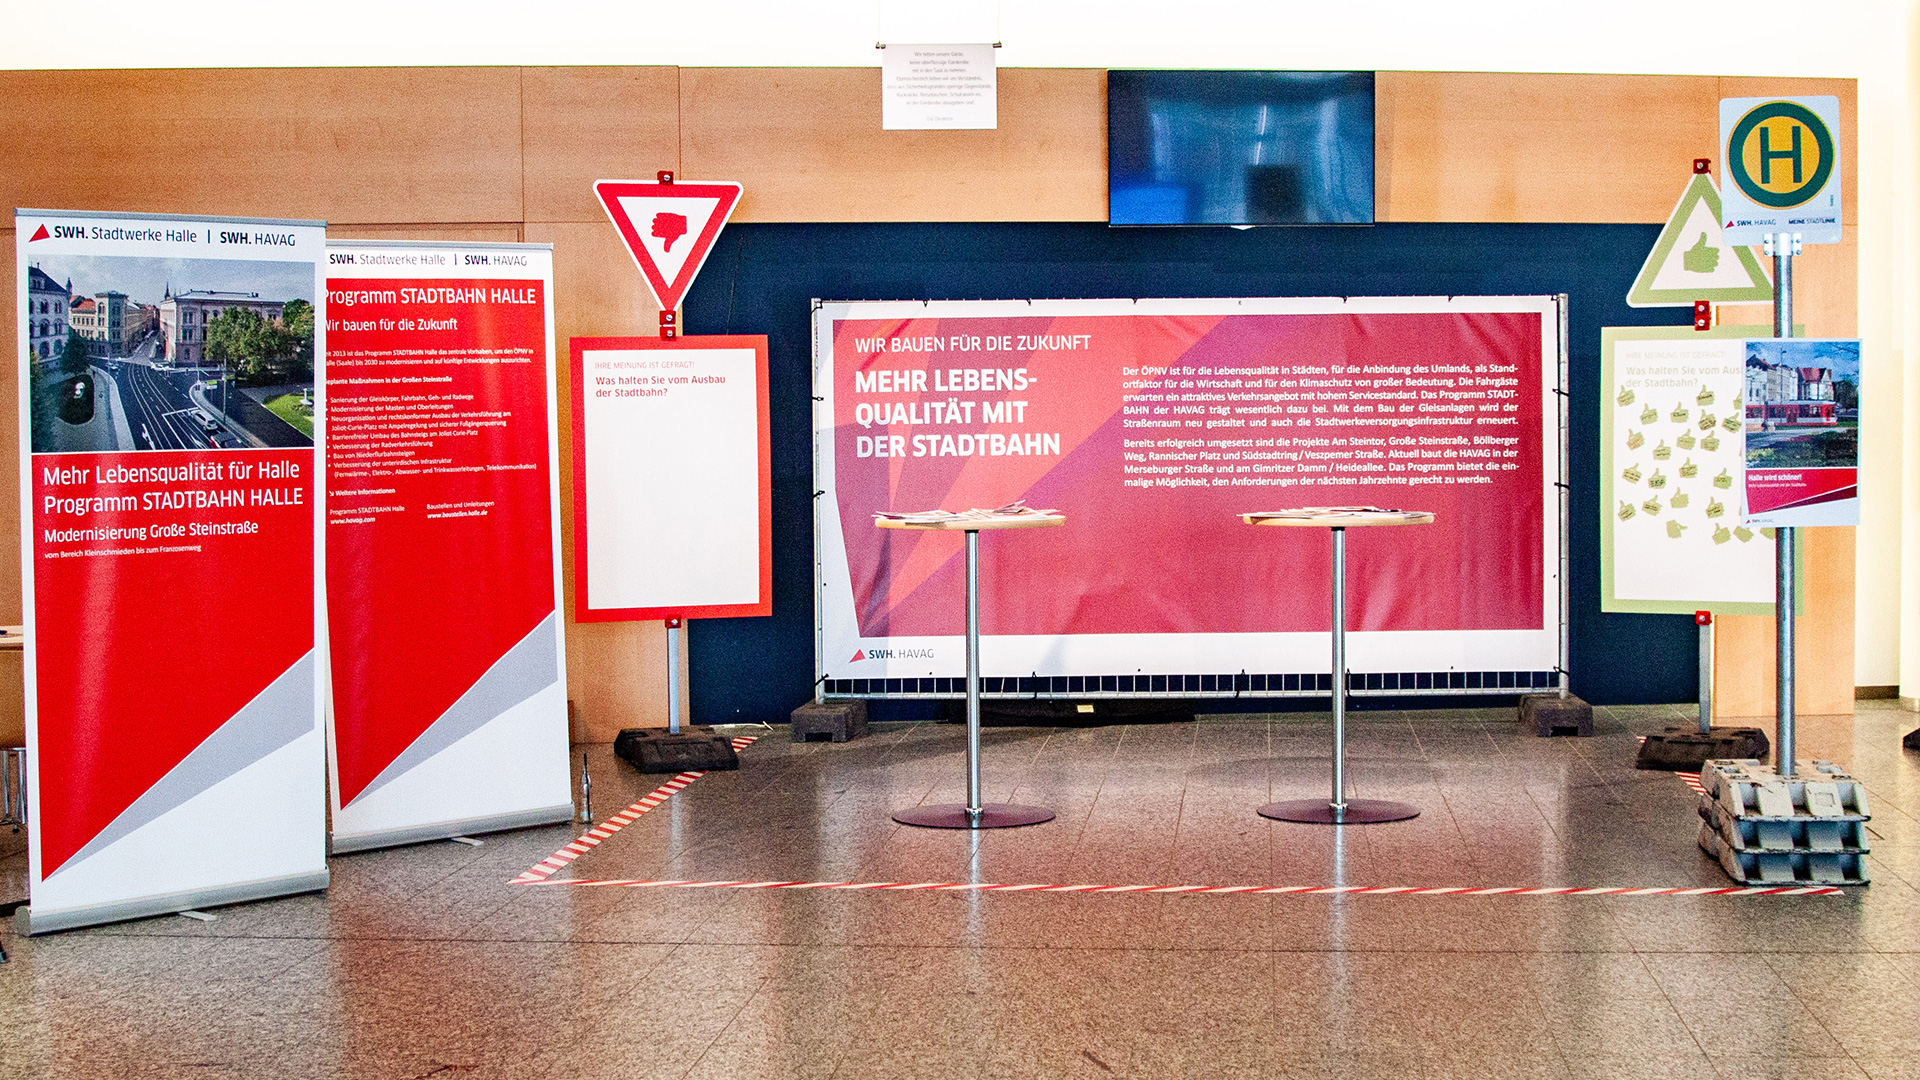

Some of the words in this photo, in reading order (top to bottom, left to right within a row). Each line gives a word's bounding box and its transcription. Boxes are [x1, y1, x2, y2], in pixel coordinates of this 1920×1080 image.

[1760, 126, 1802, 184] H
[54, 226, 88, 239] SWH.
[92, 227, 162, 242] Stadtwerke
[166, 229, 197, 243] Halle
[220, 232, 252, 245] SWH.
[255, 234, 295, 246] HAVAG
[330, 254, 357, 264] SWH.
[360, 254, 418, 265] Stadtwerke
[420, 254, 446, 265] Halle
[465, 255, 491, 265] SWH.
[494, 256, 528, 266] HAVAG
[400, 288, 486, 304] STADTBAHN
[491, 288, 536, 304] HALLE
[343, 320, 377, 331] bauen
[380, 319, 395, 331] für
[398, 319, 415, 331] die
[418, 318, 458, 330] Zukunft
[855, 338, 886, 353] WIR
[892, 337, 945, 353] BAUEN
[951, 334, 981, 352] FÜR
[986, 336, 1012, 351] DIE
[1017, 335, 1091, 351] ZUKUNFT
[1123, 367, 1139, 376] Der
[1141, 365, 1168, 376] ÖPNV
[1170, 367, 1181, 375] ist
[1183, 366, 1196, 375] für
[1198, 367, 1212, 375] die
[1214, 366, 1279, 377] Lebensqualität
[1282, 366, 1290, 374] in
[1292, 366, 1329, 375] Städten,
[1331, 365, 1345, 374] für
[1347, 365, 1361, 374] die
[1363, 365, 1411, 376] Anbindung
[1413, 364, 1429, 373] des
[1431, 364, 1473, 374] Umlands,
[1475, 364, 1488, 373] als
[1489, 364, 1518, 373] Stand-
[596, 377, 616, 385] Was
[619, 377, 648, 385] halten
[651, 376, 665, 385] Sie
[691, 376, 725, 384] Ausbau
[856, 370, 927, 393] MEHR
[935, 368, 1037, 392] LEBENS-
[1626, 379, 1641, 387] der
[1645, 378, 1698, 387] Stadtbahn?
[596, 389, 612, 397] der
[615, 388, 668, 397] Stadtbahn?
[1166, 393, 1180, 402] ein
[1181, 393, 1226, 402] attraktives
[1227, 392, 1299, 403] Verkehrsangebot
[1301, 392, 1315, 400] mit
[1317, 391, 1348, 400] hohem
[1349, 391, 1419, 400] Servicestandard.
[1421, 391, 1438, 399] Das
[1439, 390, 1486, 401] Programm
[1487, 390, 1519, 399] STADT-
[856, 398, 976, 429] QUALITÄT
[983, 401, 1028, 424] MIT
[1123, 418, 1181, 428] Straßenraum
[1207, 418, 1245, 429] gestaltet
[1250, 418, 1267, 427] und
[1271, 418, 1293, 427] auch
[1297, 418, 1311, 427] die
[1315, 416, 1474, 428] Stadtwerkeversorgungsinfrastruktur
[857, 435, 905, 458] DER
[913, 433, 1060, 457] STADTBAHN
[1124, 439, 1155, 448] Bereits
[1157, 438, 1205, 450] erfolgreich
[1207, 439, 1253, 449] umgesetzt
[1255, 438, 1274, 447] sind
[1276, 438, 1290, 447] die
[1293, 437, 1330, 448] Projekte
[1332, 438, 1347, 446] Am
[1349, 437, 1386, 446] Steintor,
[1389, 436, 1417, 446] Große
[1419, 436, 1471, 446] Steinstraße,
[1474, 436, 1519, 446] Böllberger
[44, 466, 90, 486] Mehr
[96, 462, 223, 486] Lebensqualität
[228, 461, 253, 480] für
[259, 460, 300, 479] Halle
[1124, 478, 1154, 489] malige
[1156, 477, 1210, 488] Möglichkeit,
[1212, 478, 1229, 486] den
[1231, 477, 1298, 488] Anforderungen
[1300, 476, 1316, 485] der
[1317, 476, 1358, 485] nächsten
[1359, 476, 1408, 485] Jahrzehnte
[1409, 475, 1443, 486] gerecht
[1457, 475, 1493, 484] werden.
[45, 493, 138, 517] Programm
[143, 489, 244, 511] STADTBAHN
[251, 488, 303, 506] HALLE
[45, 525, 147, 544] Modernisierung
[150, 523, 186, 538] Große
[189, 520, 258, 536] Steinstraße
[85, 548, 135, 557] Kleinschmieden
[160, 544, 202, 554] Franzosenweg
[869, 648, 896, 659] SWH.
[899, 648, 934, 658] HAVAG
